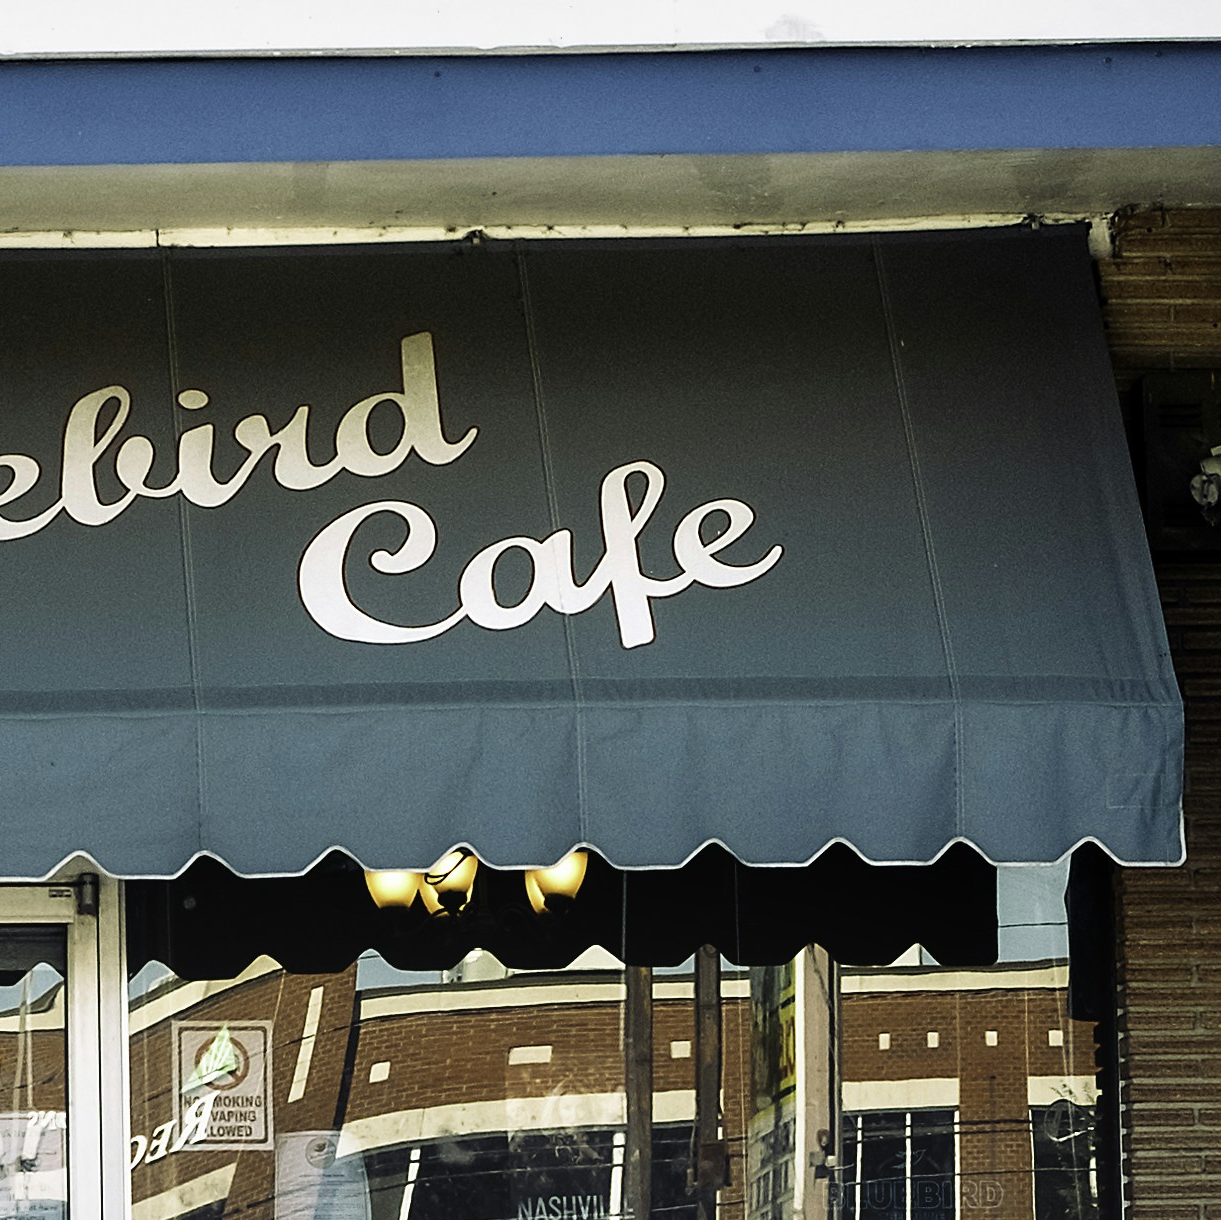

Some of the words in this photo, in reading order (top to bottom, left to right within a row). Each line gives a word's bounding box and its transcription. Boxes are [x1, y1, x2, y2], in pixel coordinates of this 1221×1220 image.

[299, 460, 783, 650] Cafe
[213, 1095, 263, 1107] MOKING
[206, 1125, 253, 1137] LOWED
